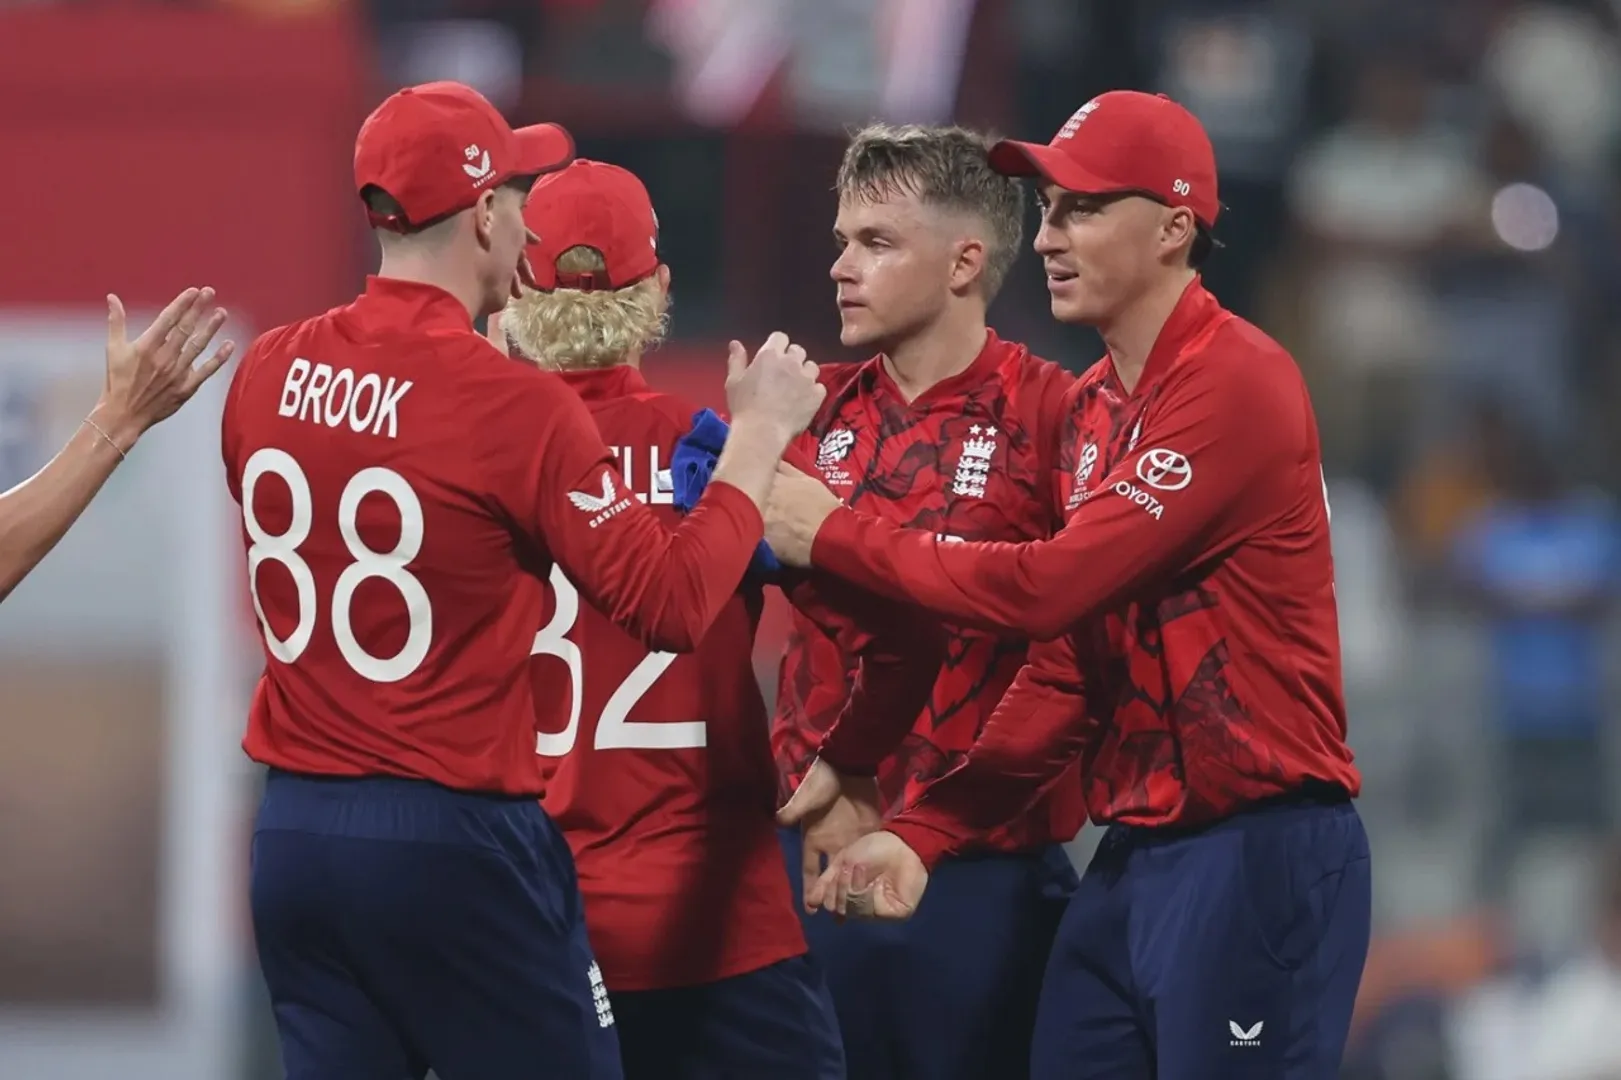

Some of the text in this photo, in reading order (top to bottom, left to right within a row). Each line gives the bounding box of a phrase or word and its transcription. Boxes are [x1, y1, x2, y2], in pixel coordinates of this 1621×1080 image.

[464, 144, 480, 160] 50
[1172, 178, 1190, 196] 90
[278, 357, 413, 438] BROOK
[242, 447, 432, 683] 88
